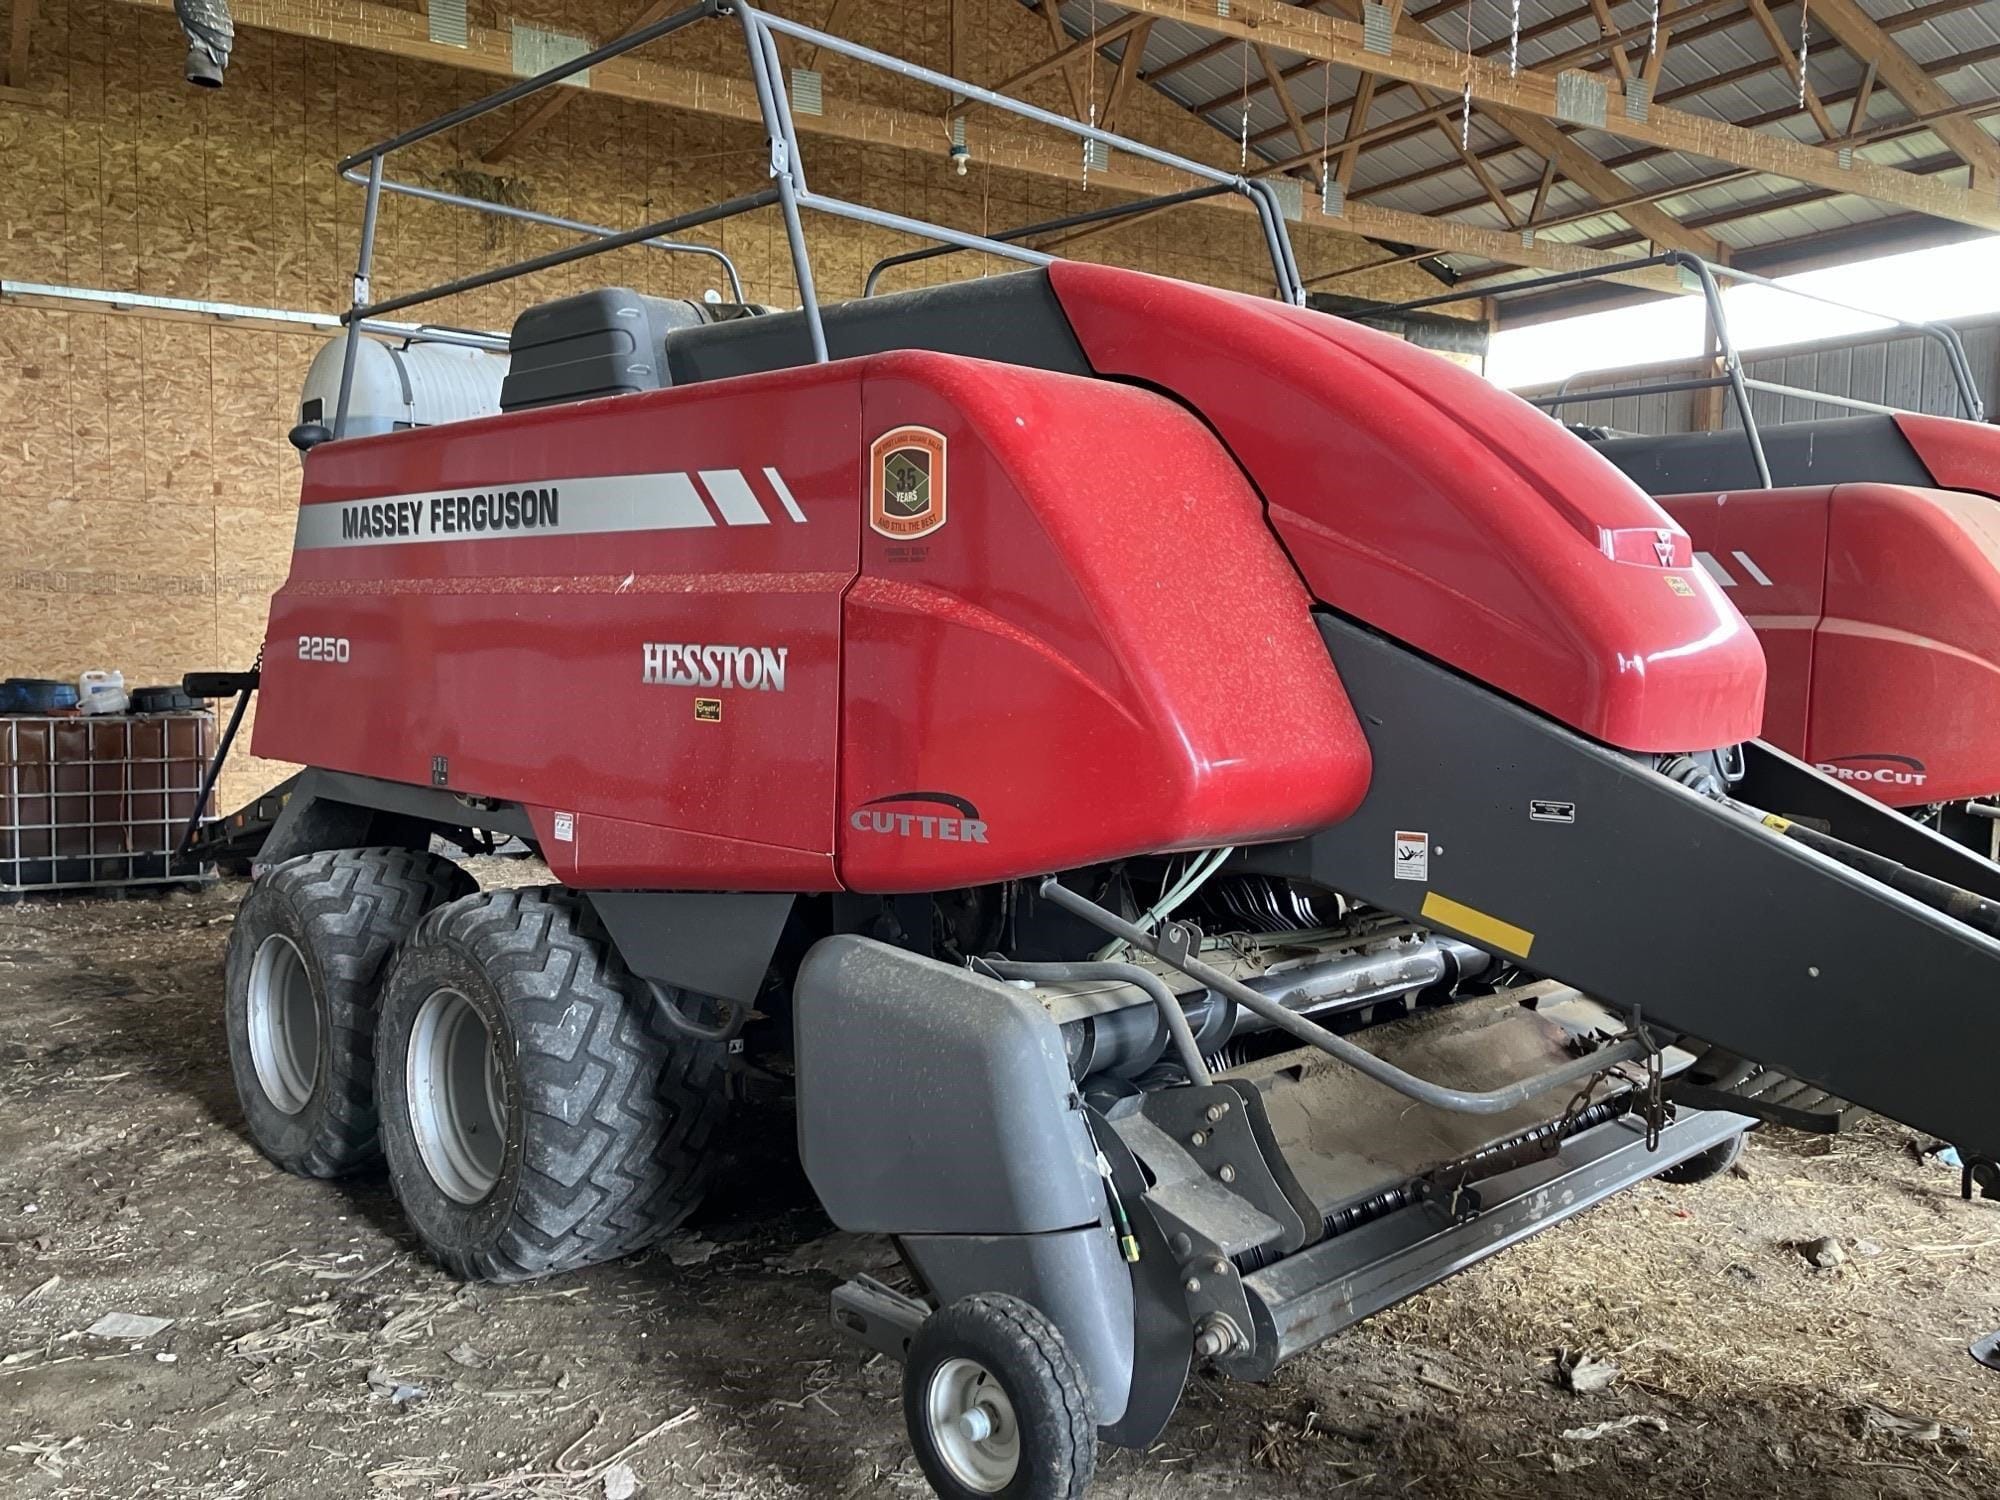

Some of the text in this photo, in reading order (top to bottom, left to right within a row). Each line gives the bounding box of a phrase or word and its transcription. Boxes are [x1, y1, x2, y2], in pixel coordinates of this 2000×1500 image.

[896, 468, 916, 491] 35
[896, 490, 918, 503] YEARS
[342, 488, 559, 539] MASSEY FERGUSON
[878, 513, 937, 532] AND STILL THE BEST
[298, 636, 350, 663] 2250
[642, 643, 788, 693] HESSTON
[851, 810, 989, 844] CUTTER
